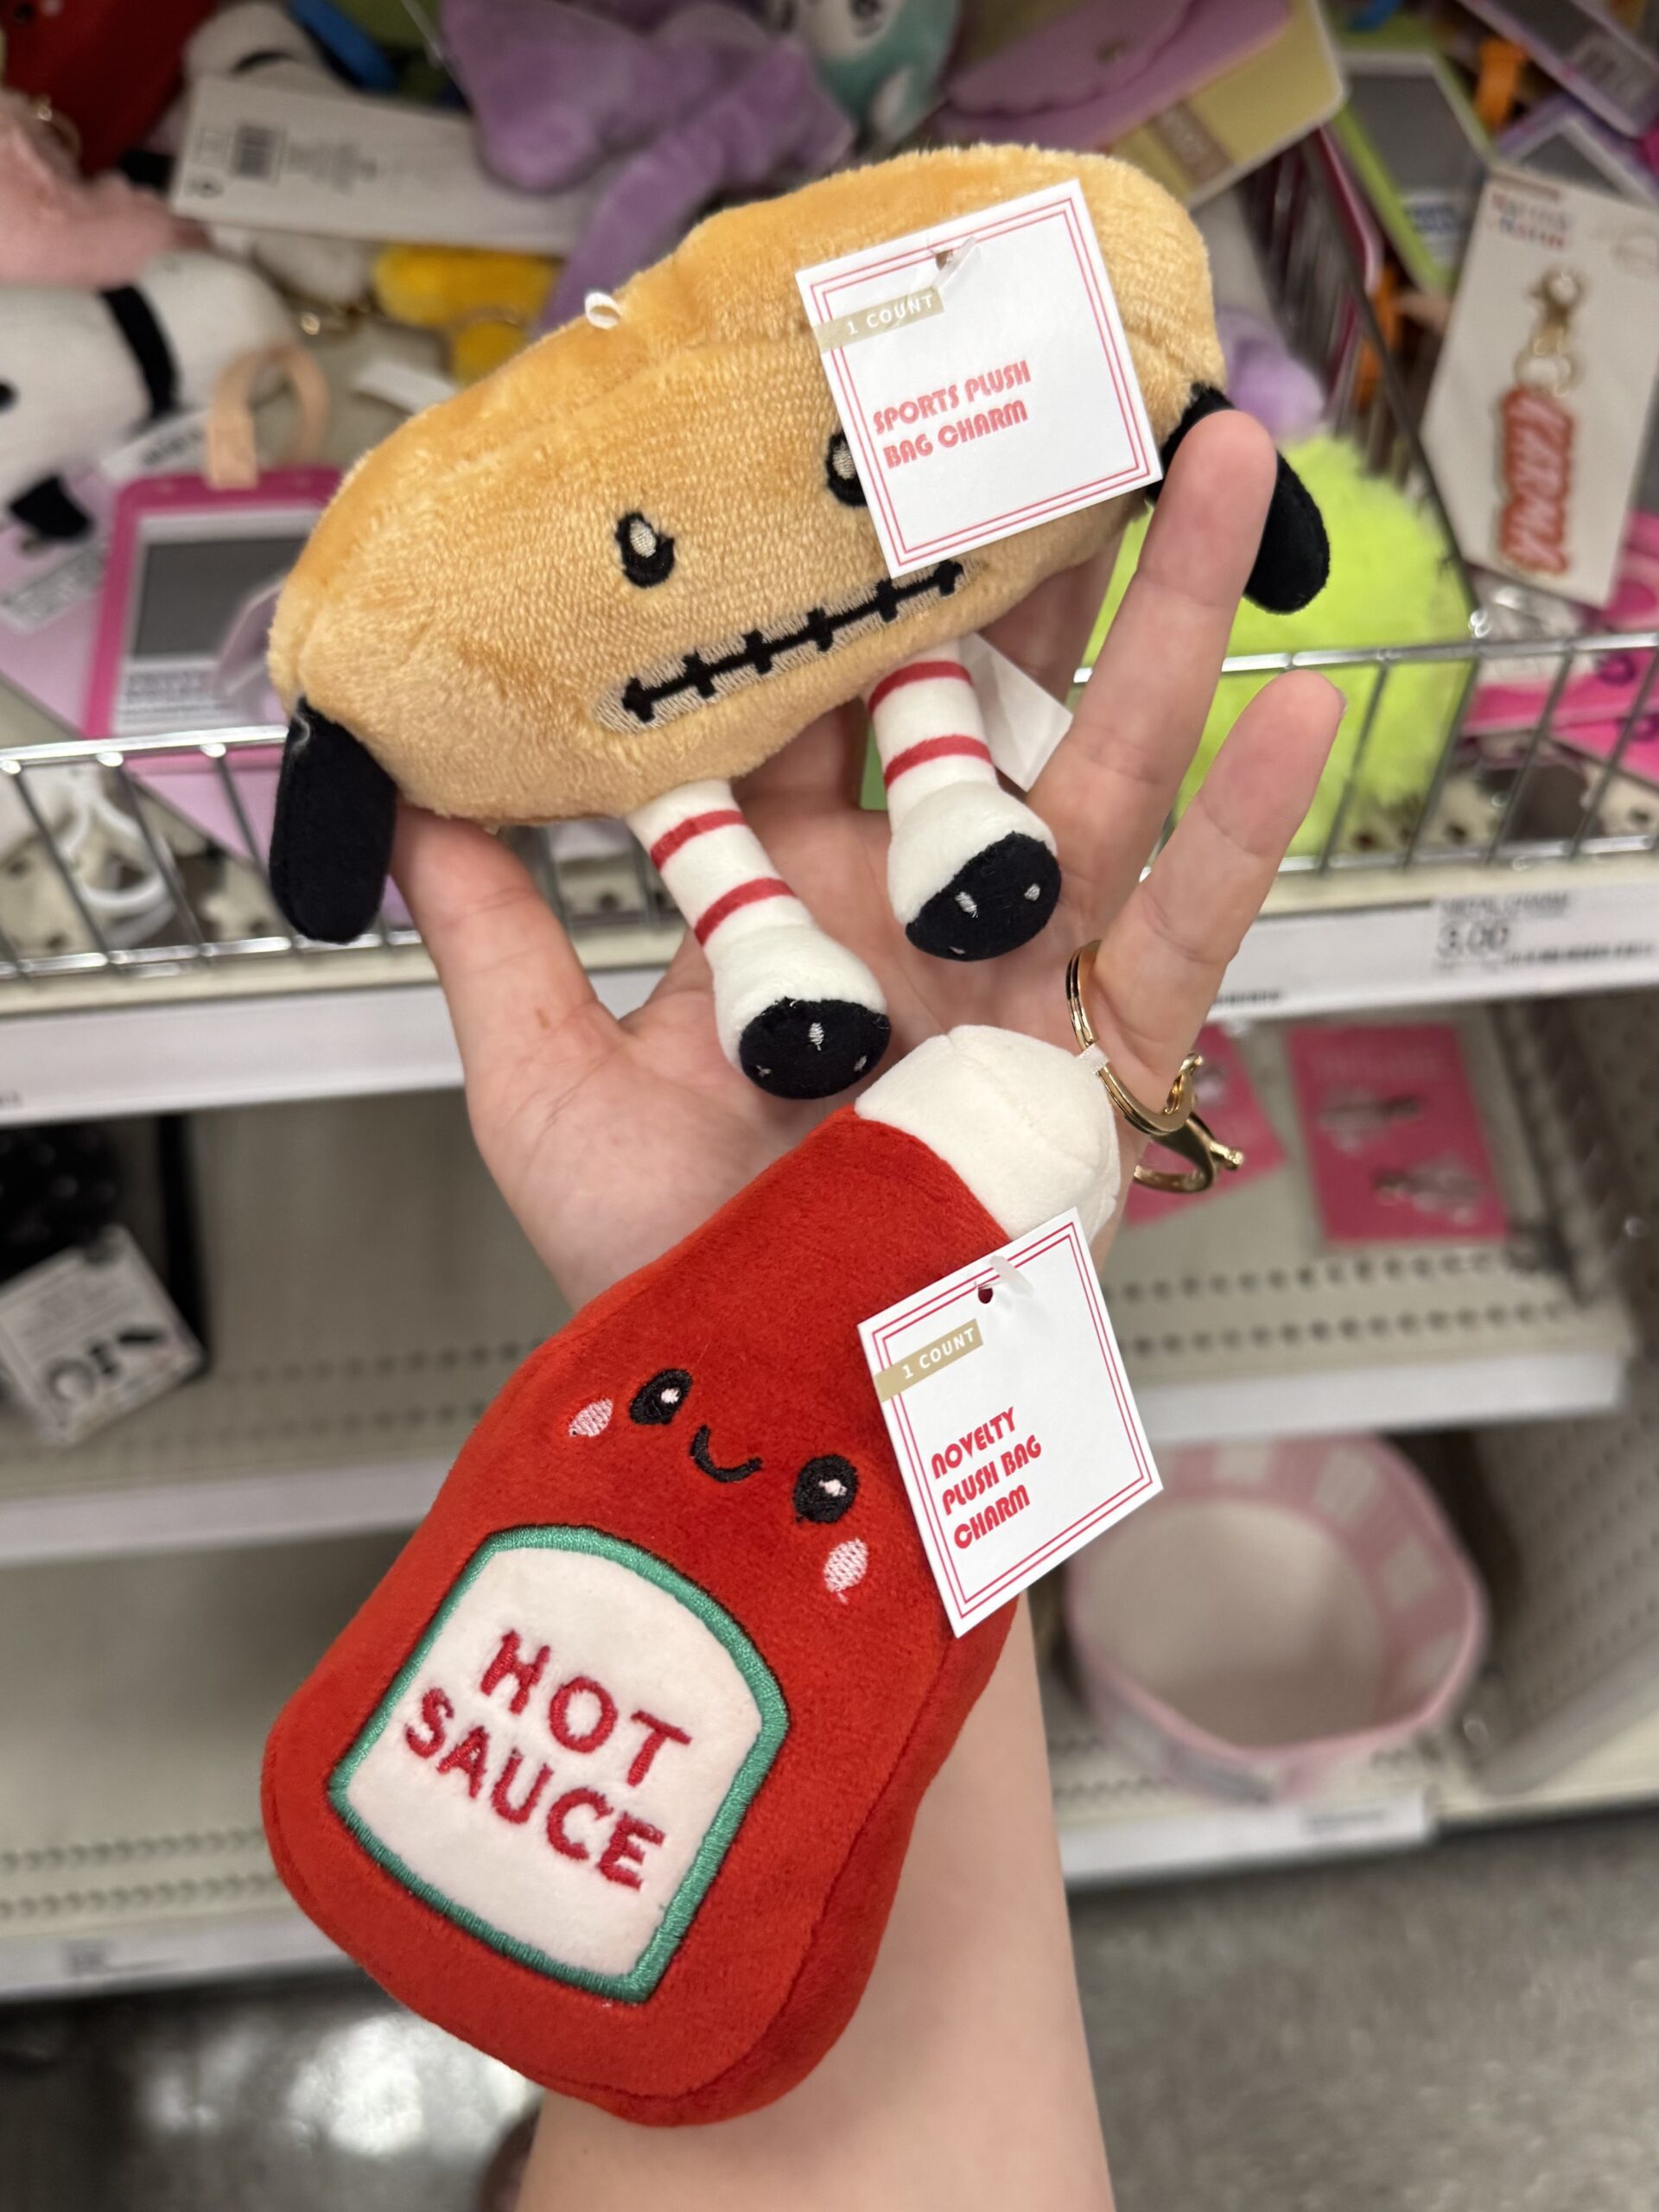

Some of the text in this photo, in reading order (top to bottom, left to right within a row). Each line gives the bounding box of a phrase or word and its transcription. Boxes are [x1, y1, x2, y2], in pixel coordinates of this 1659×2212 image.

[846, 295, 934, 335] 1 COUNT
[872, 359, 1032, 435] SPORTS PLUSH
[883, 399, 1028, 469] BAG CHARM
[902, 1327, 976, 1379] 1 COUNT
[931, 1406, 1015, 1479] NOVELTY
[943, 1434, 1042, 1516] PLUSH BAG
[953, 1484, 1030, 1549] CHARM
[480, 1629, 692, 1787] HOT
[404, 1687, 666, 1891] SAUCE
